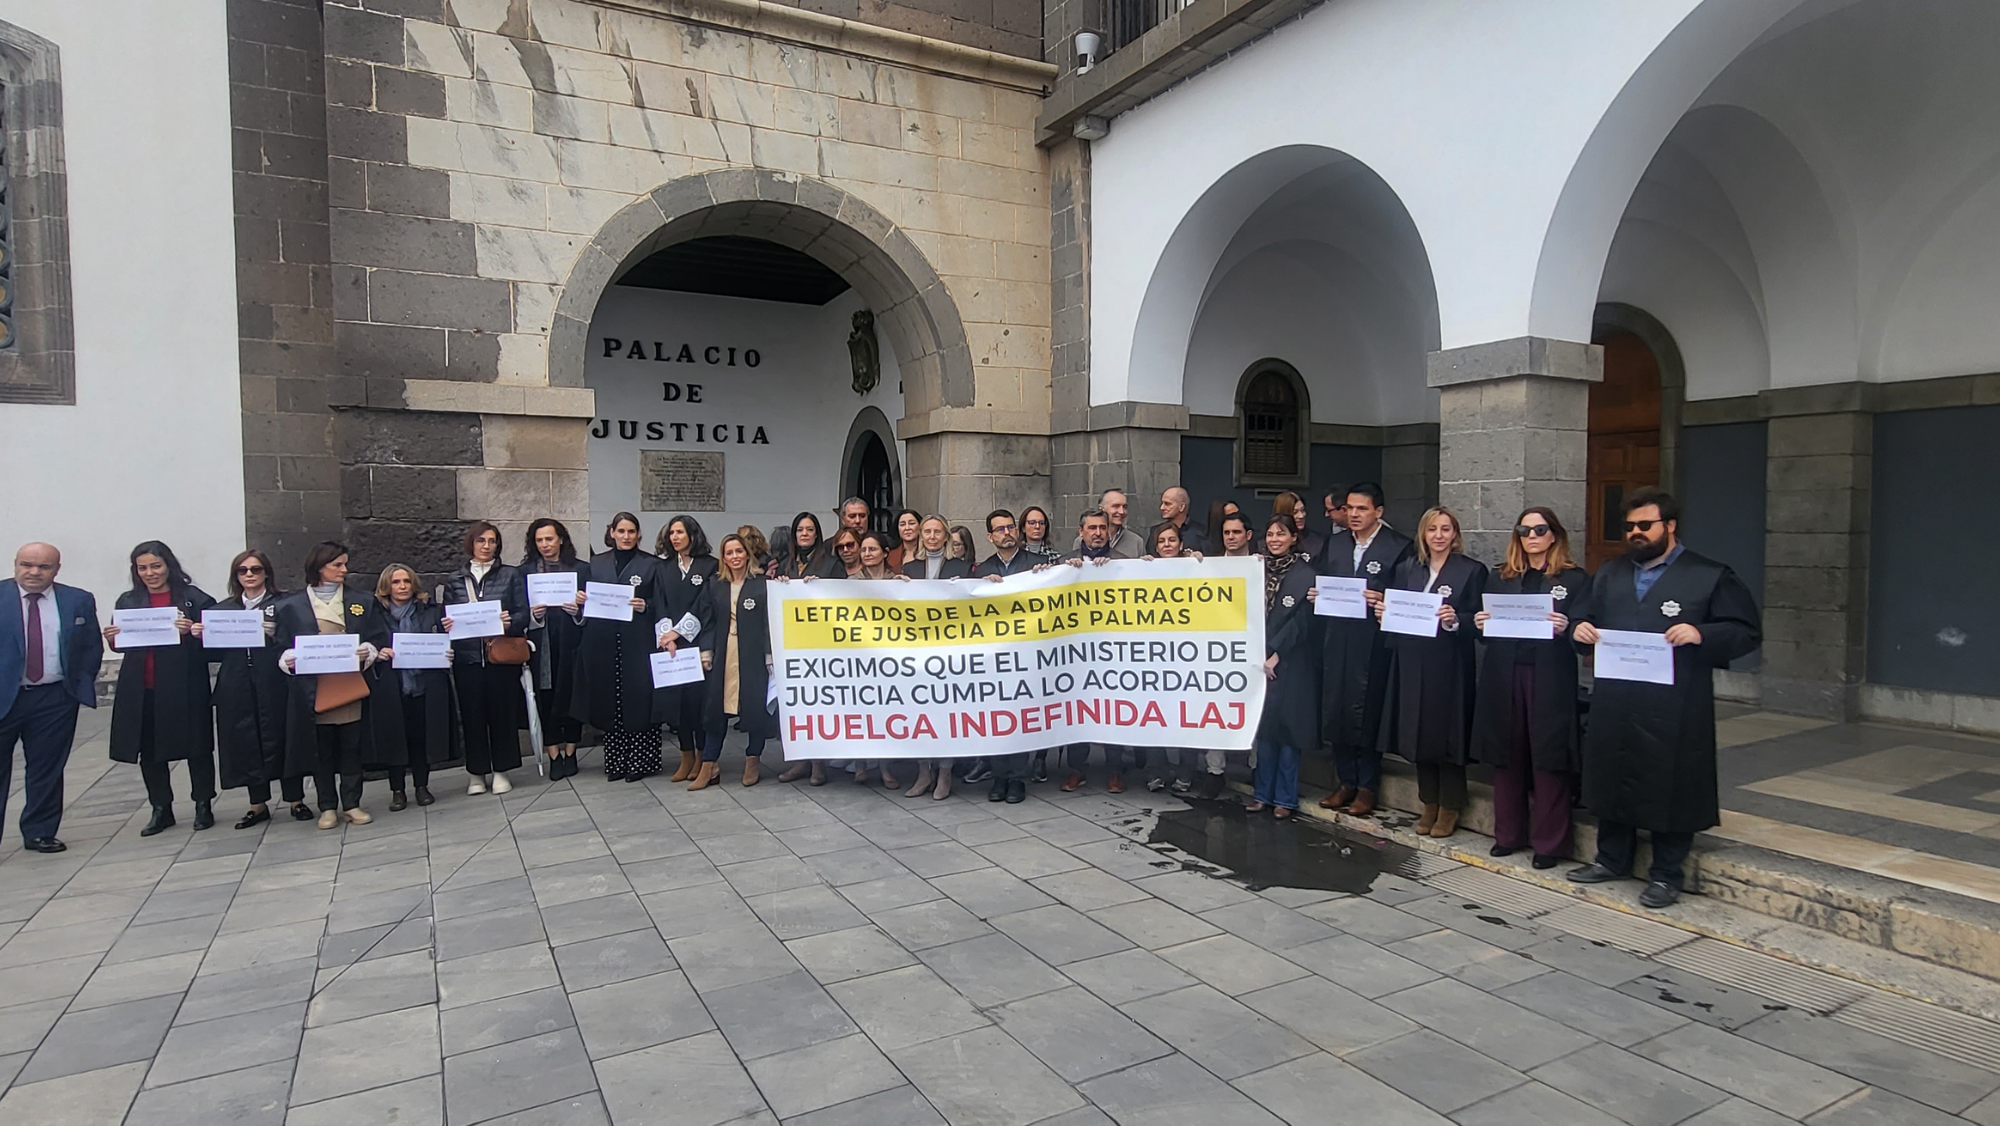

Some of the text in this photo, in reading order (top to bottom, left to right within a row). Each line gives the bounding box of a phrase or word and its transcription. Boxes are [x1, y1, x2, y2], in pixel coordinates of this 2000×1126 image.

[603, 337, 761, 368] PALACIO
[663, 382, 703, 404] DE
[591, 419, 770, 445] JUSTICIA
[794, 582, 1233, 623] LETRADOS DE LA ADMINISTRACIÓN
[833, 608, 1191, 643] DE JUSTICIA DE LAS PALMAS
[785, 640, 1247, 680] EXIGIMOS QUE EL MINISTERIO DE
[785, 669, 1248, 707] JUSTICIA CUMPLA LO ACORDADO
[789, 698, 1246, 742] HUELGA INDEFINIDA LAJ
